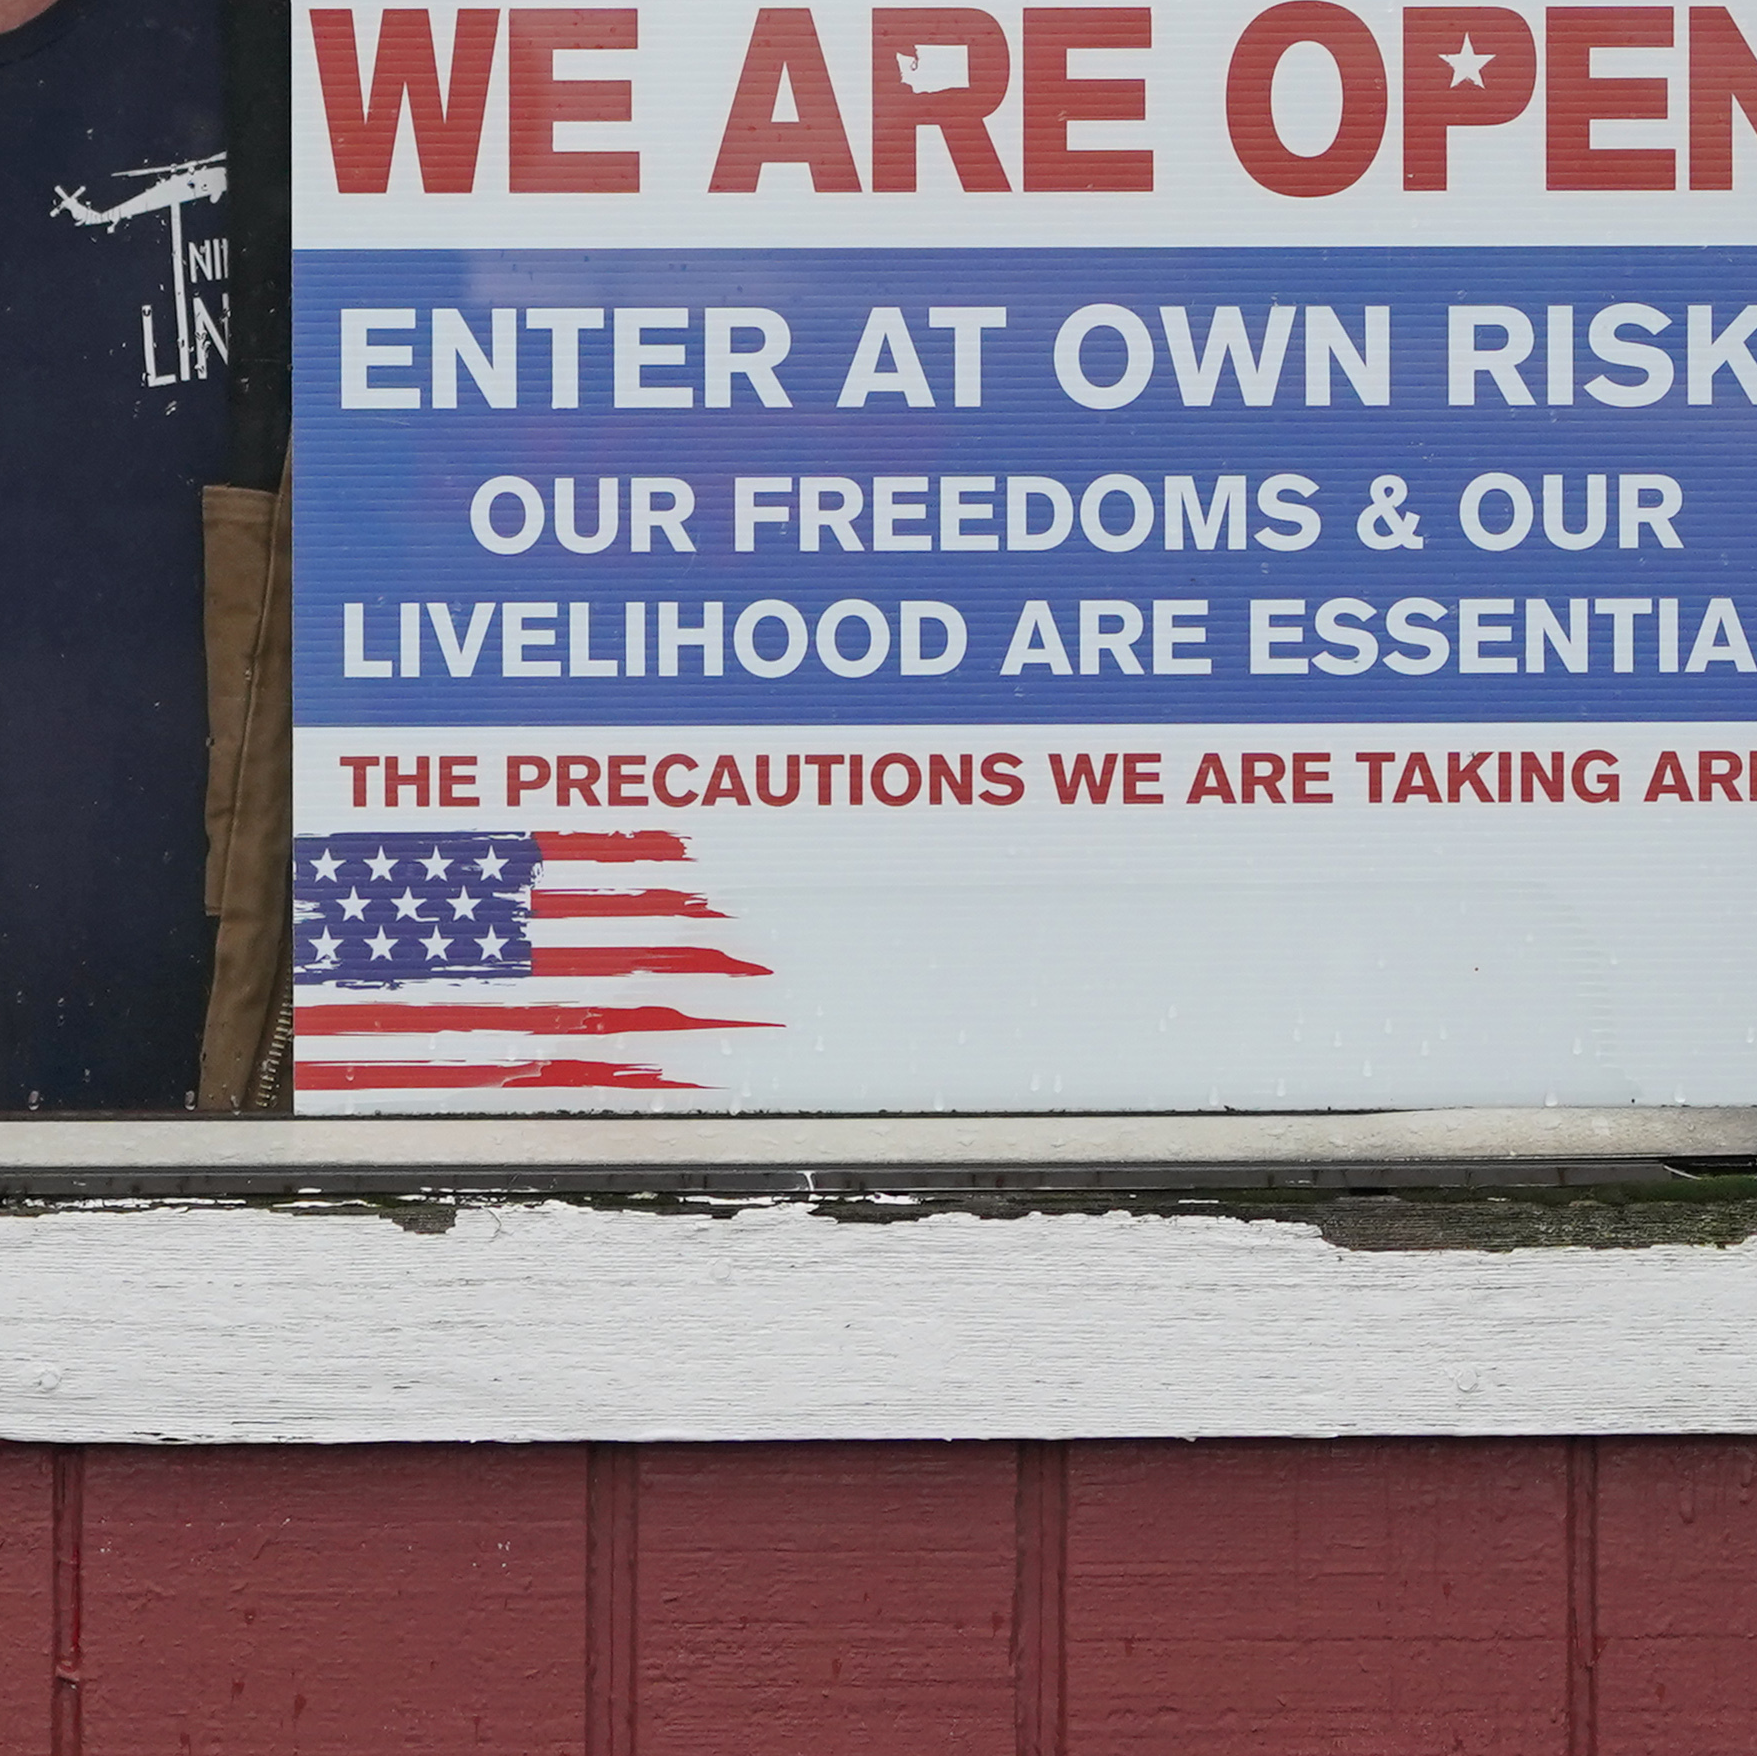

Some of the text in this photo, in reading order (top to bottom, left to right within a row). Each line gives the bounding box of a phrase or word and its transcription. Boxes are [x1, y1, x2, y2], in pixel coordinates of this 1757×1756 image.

[309, 9, 641, 195] WE
[708, 8, 1154, 194] ARE
[340, 307, 793, 412] ENTER
[838, 306, 1008, 410] AT
[1053, 303, 1391, 412] OWN
[470, 473, 1684, 556] OUR FREEDOMS & OUR
[344, 598, 969, 680] LIVELIHOOD
[1001, 599, 1213, 678] ARE
[341, 755, 481, 809] THE
[507, 753, 1026, 809] PRECAUTIONS
[1049, 753, 1165, 806] WE
[1189, 752, 1333, 806] ARE
[1356, 751, 1620, 805] TAKING
